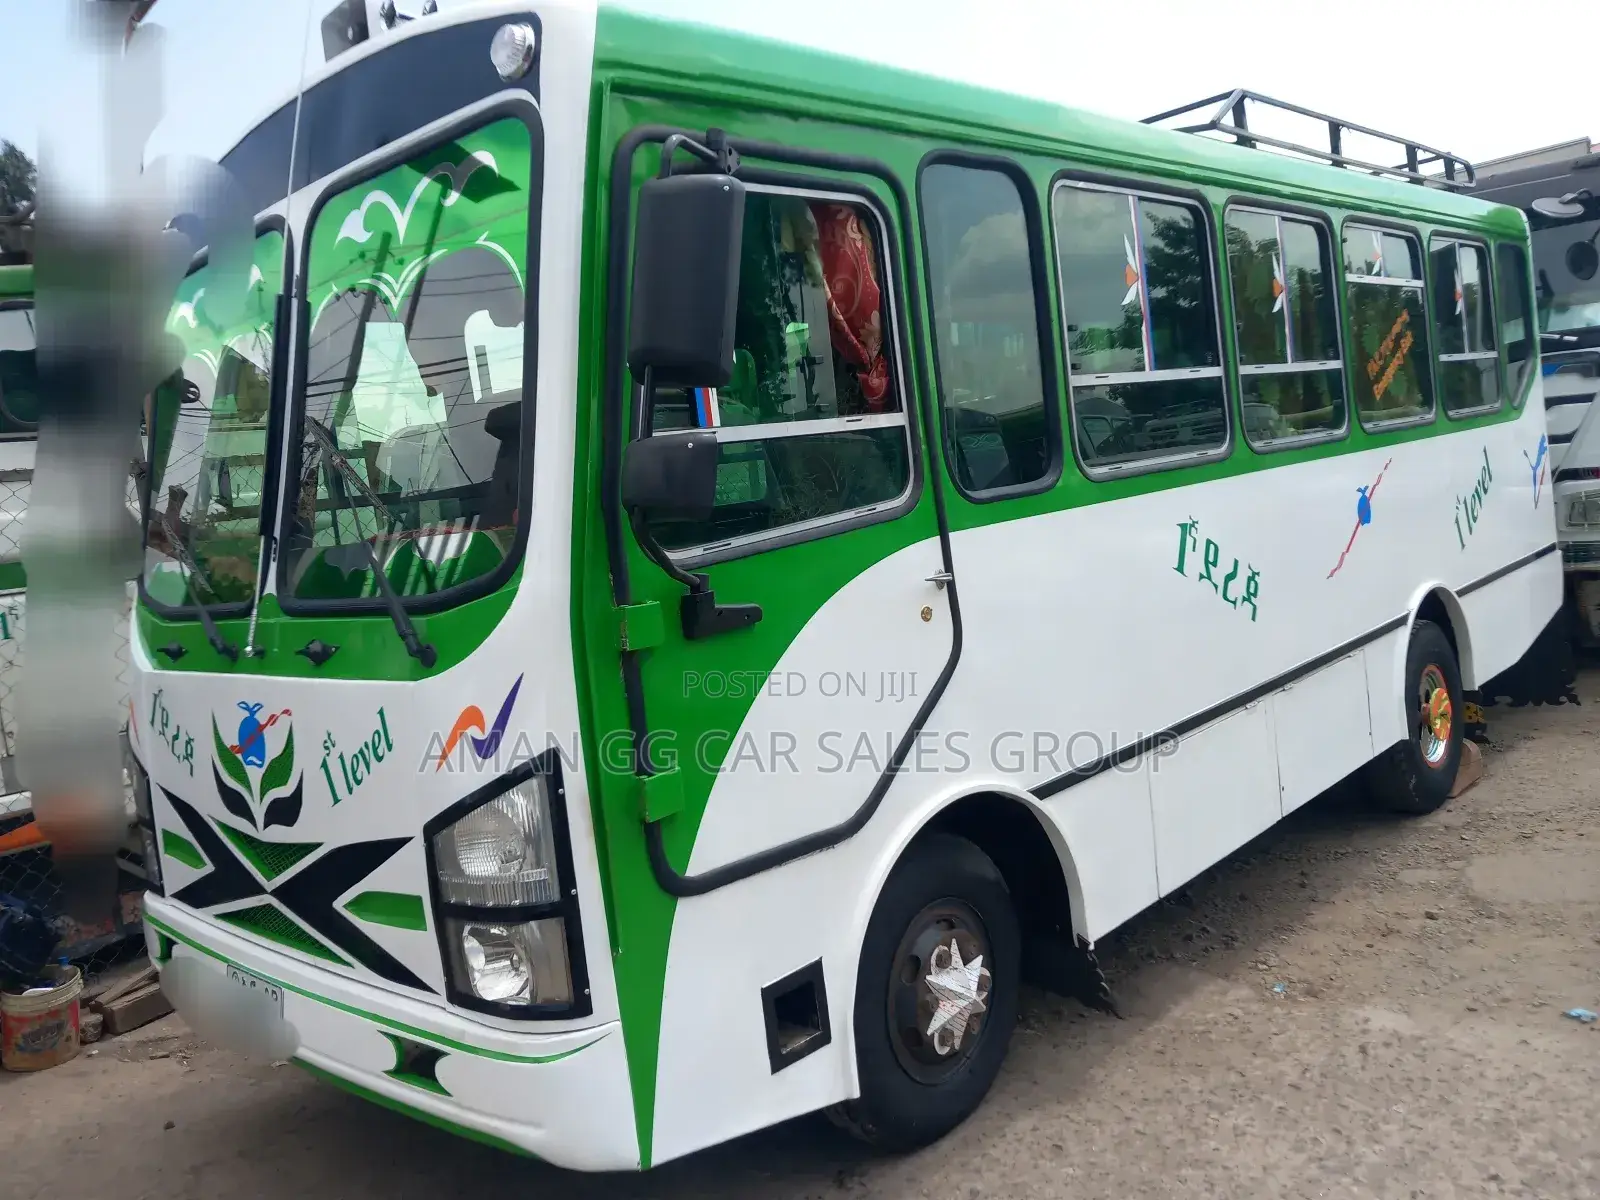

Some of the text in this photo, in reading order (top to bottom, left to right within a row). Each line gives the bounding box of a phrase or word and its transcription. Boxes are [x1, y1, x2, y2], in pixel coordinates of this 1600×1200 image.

[1463, 445, 1492, 535] level
[1198, 538, 1260, 622] ደረጃ
[337, 706, 394, 796] level
